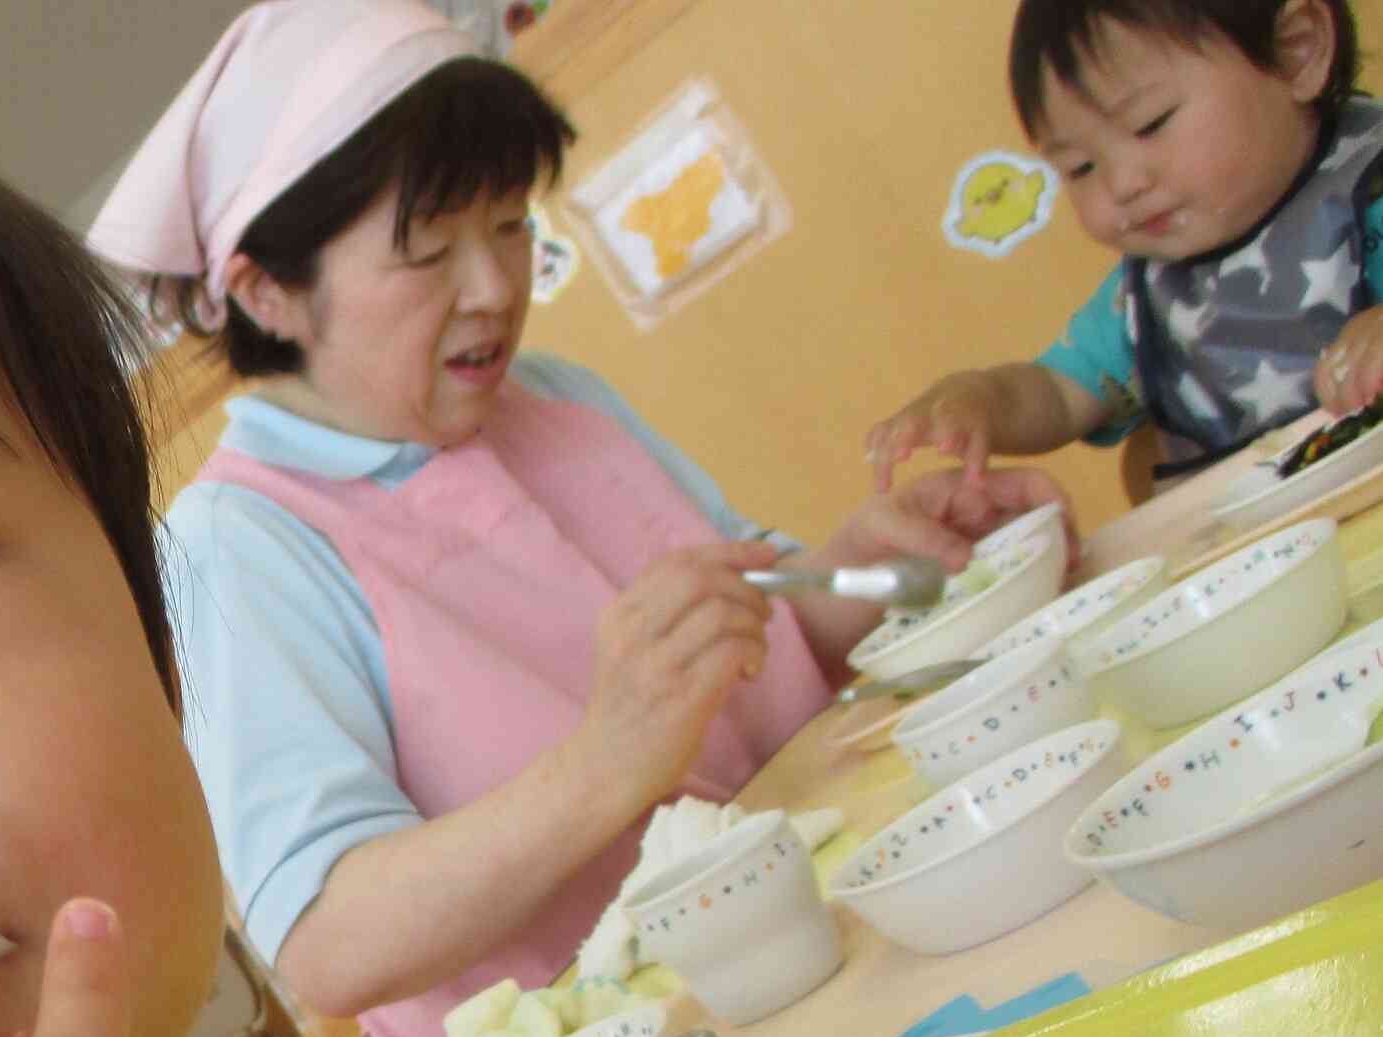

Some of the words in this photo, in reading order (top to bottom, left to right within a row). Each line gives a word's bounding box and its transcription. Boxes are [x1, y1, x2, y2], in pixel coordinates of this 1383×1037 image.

[1199, 750, 1220, 769] H
[1234, 714, 1255, 732] I
[1284, 690, 1296, 711] J
[1333, 672, 1353, 692] K
